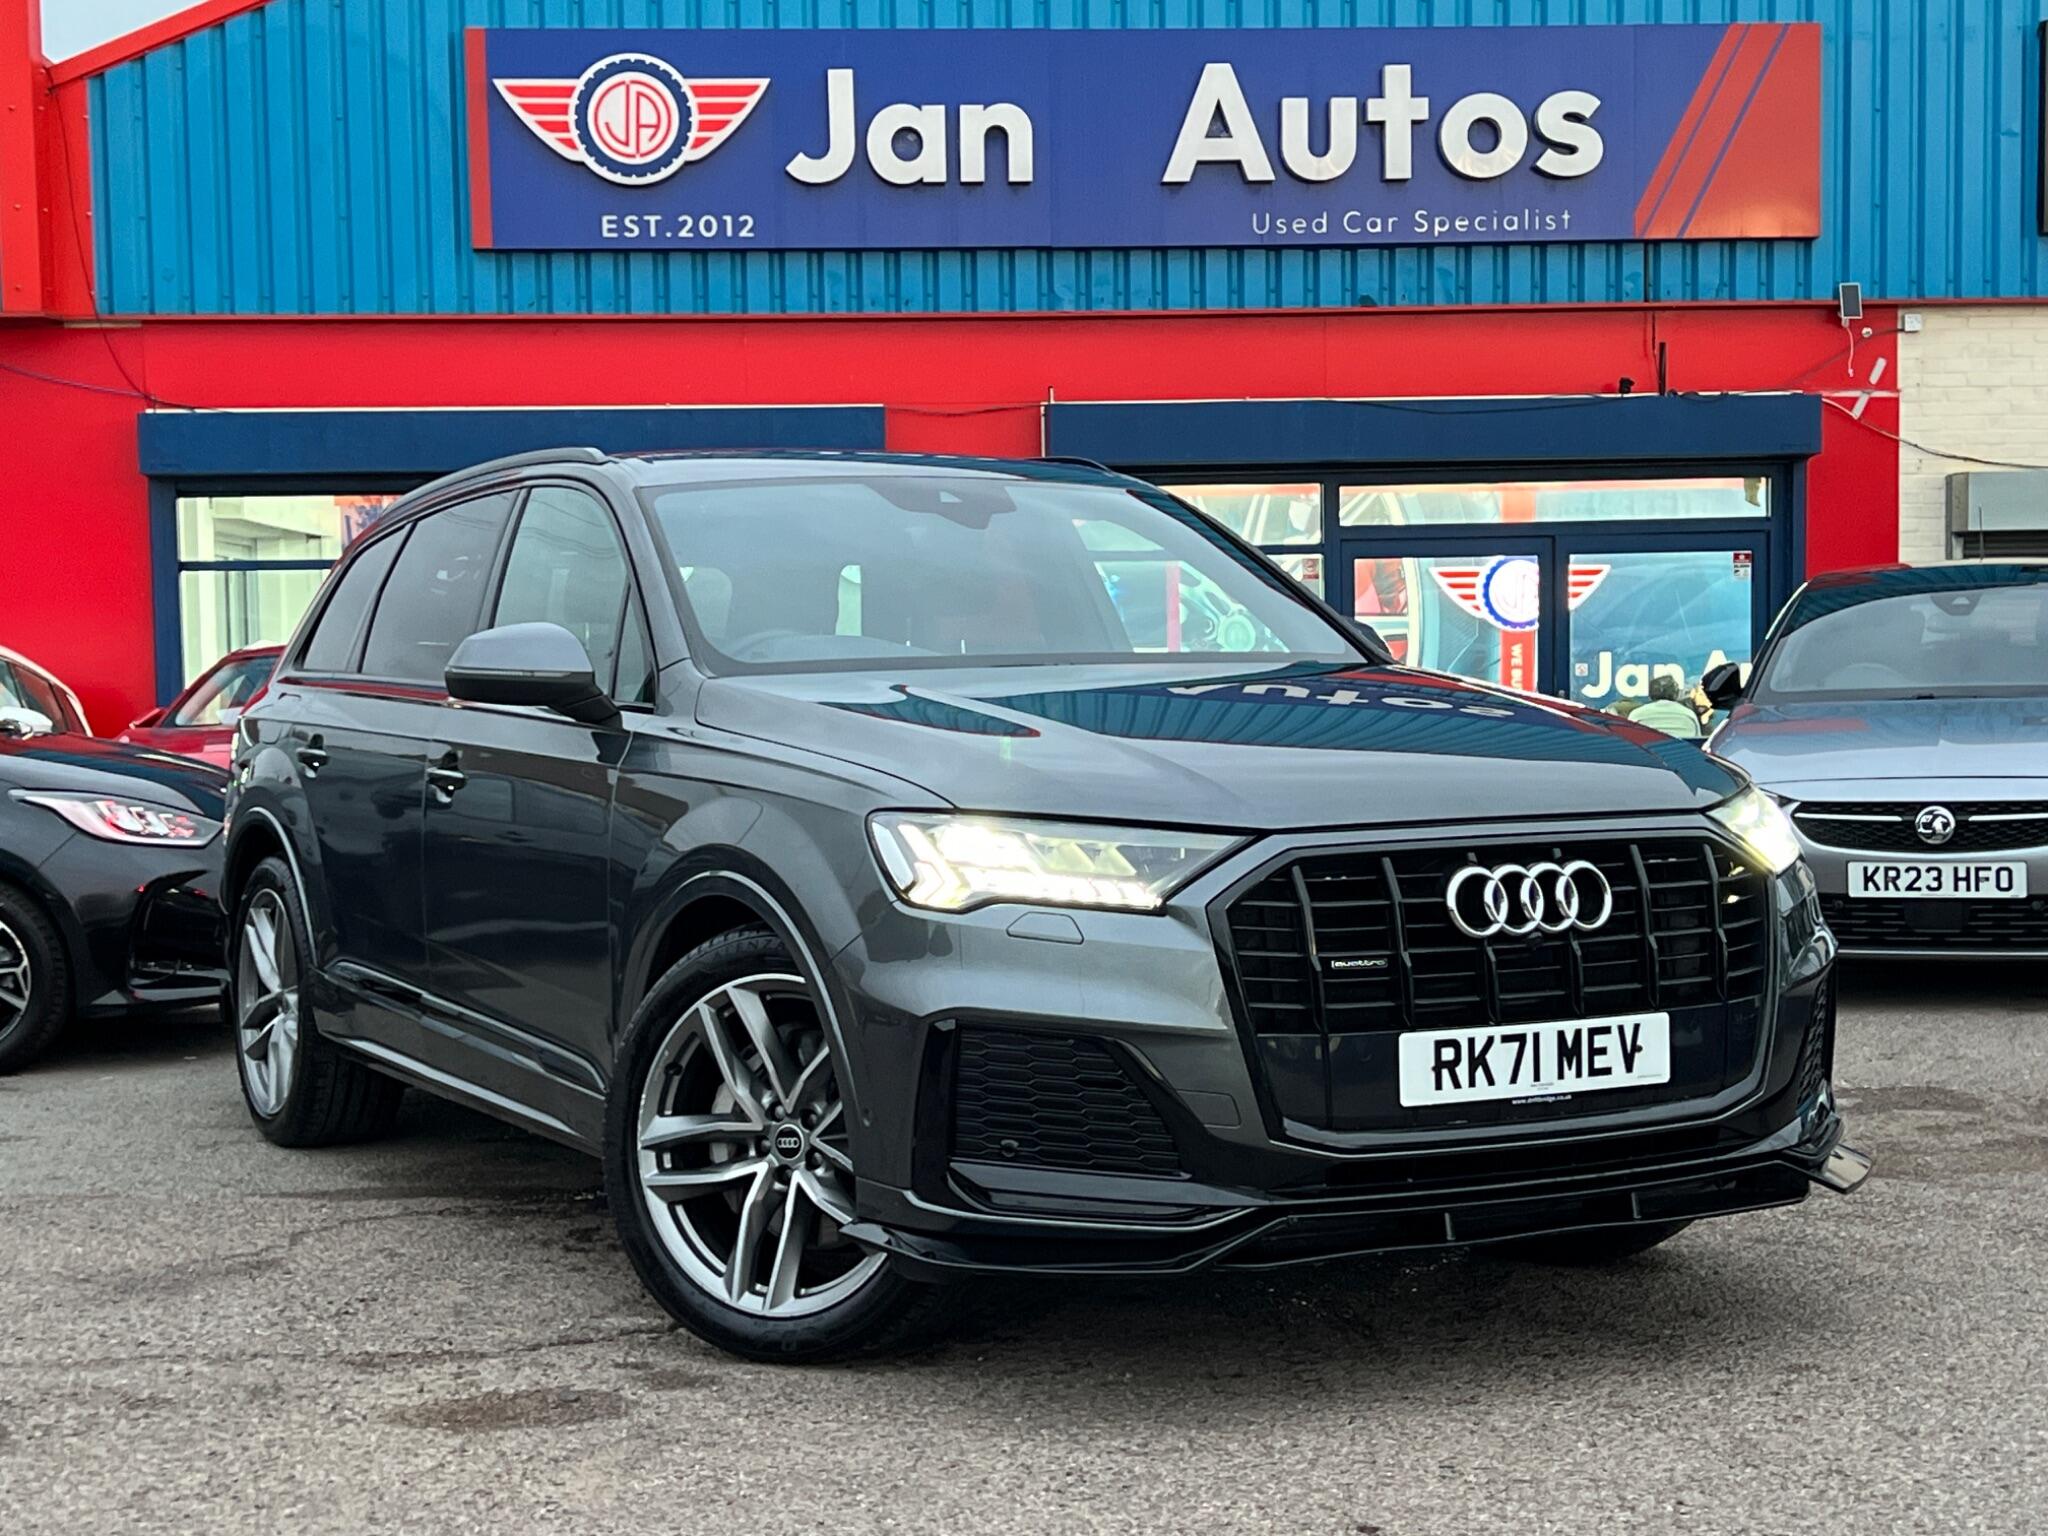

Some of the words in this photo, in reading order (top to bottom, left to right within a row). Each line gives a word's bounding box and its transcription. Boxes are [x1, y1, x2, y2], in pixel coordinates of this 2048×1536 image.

[785, 68, 1034, 184] Jan
[1161, 63, 1604, 182] Autos
[601, 214, 755, 238] EST.2012
[1252, 211, 1327, 234] Used
[1343, 210, 1399, 233] Car
[1414, 208, 1571, 237] Specialist
[1511, 643, 1523, 666] WE
[1511, 668, 1523, 690] BU
[1581, 650, 1685, 698] Jan
[1862, 866, 1943, 892] KR23
[1953, 866, 2013, 892] HFO
[1433, 1032, 1541, 1091] RK71
[1557, 1023, 1641, 1080] MEV
